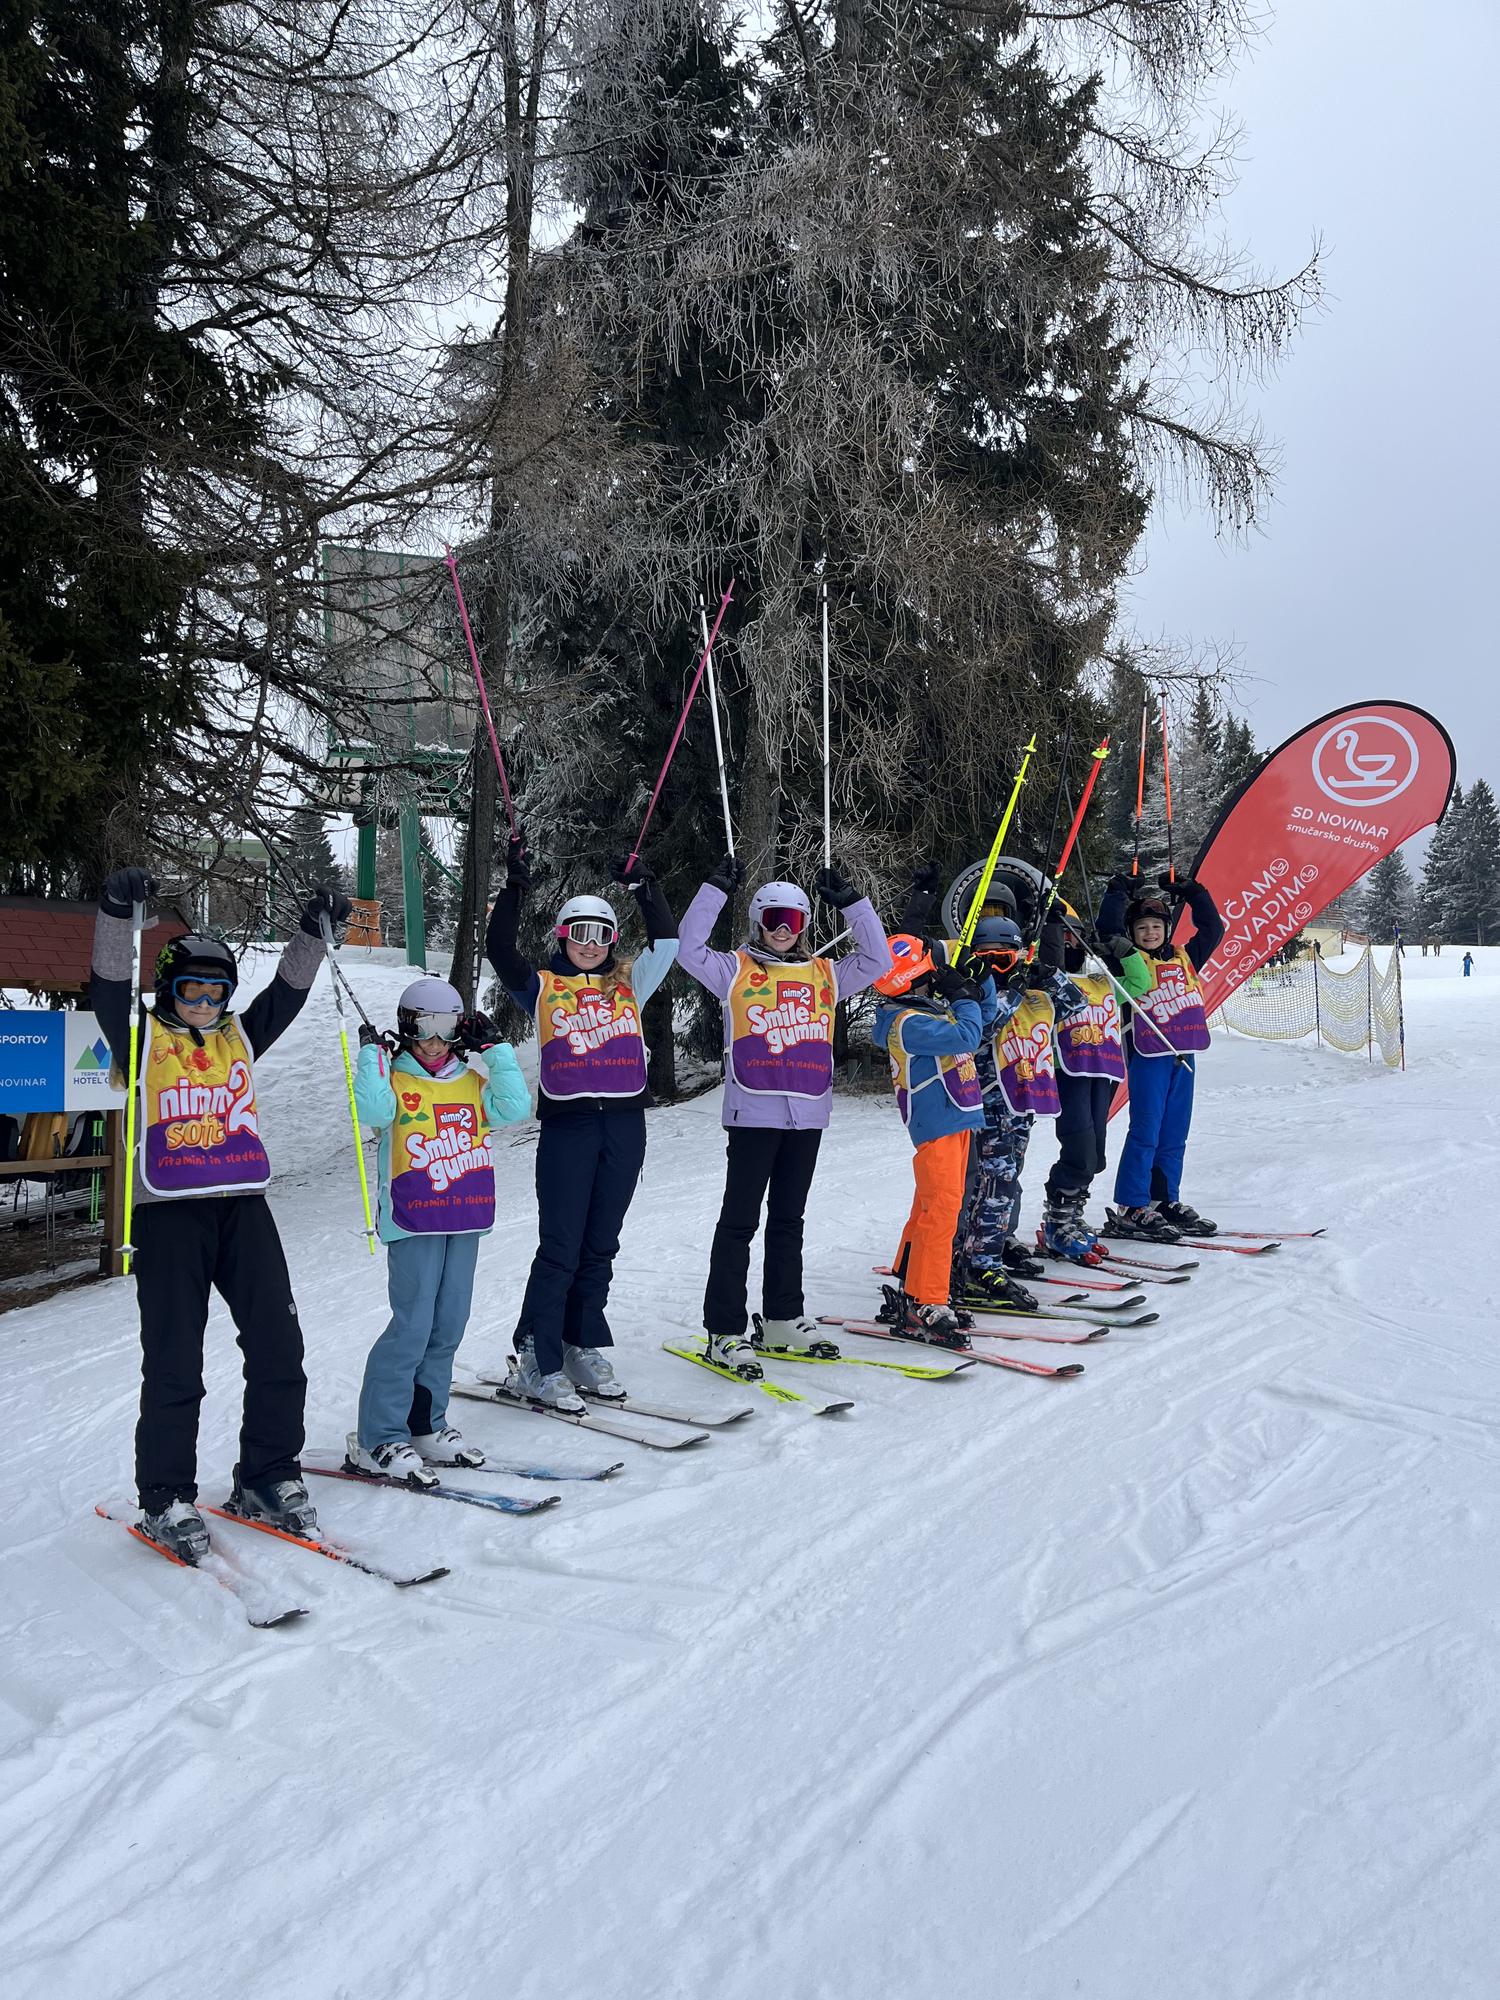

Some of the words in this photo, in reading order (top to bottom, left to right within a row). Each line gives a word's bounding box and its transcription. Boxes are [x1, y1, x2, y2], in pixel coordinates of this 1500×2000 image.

[1286, 823, 1341, 842] smučarsko
[1343, 835, 1380, 853] društvo
[1291, 806, 1314, 820] SD
[1317, 811, 1390, 840] NOVINAR
[782, 986, 812, 1006] nimm2
[551, 1004, 614, 1038] Smile
[568, 1008, 639, 1055] gummi
[747, 1001, 810, 1035] Smile
[766, 1014, 829, 1054] gummi
[158, 1060, 259, 1138] nimm2
[165, 1112, 226, 1150] soft
[439, 1107, 473, 1130] nimm2
[406, 1126, 473, 1169] Smile
[428, 1135, 494, 1192] gummi
